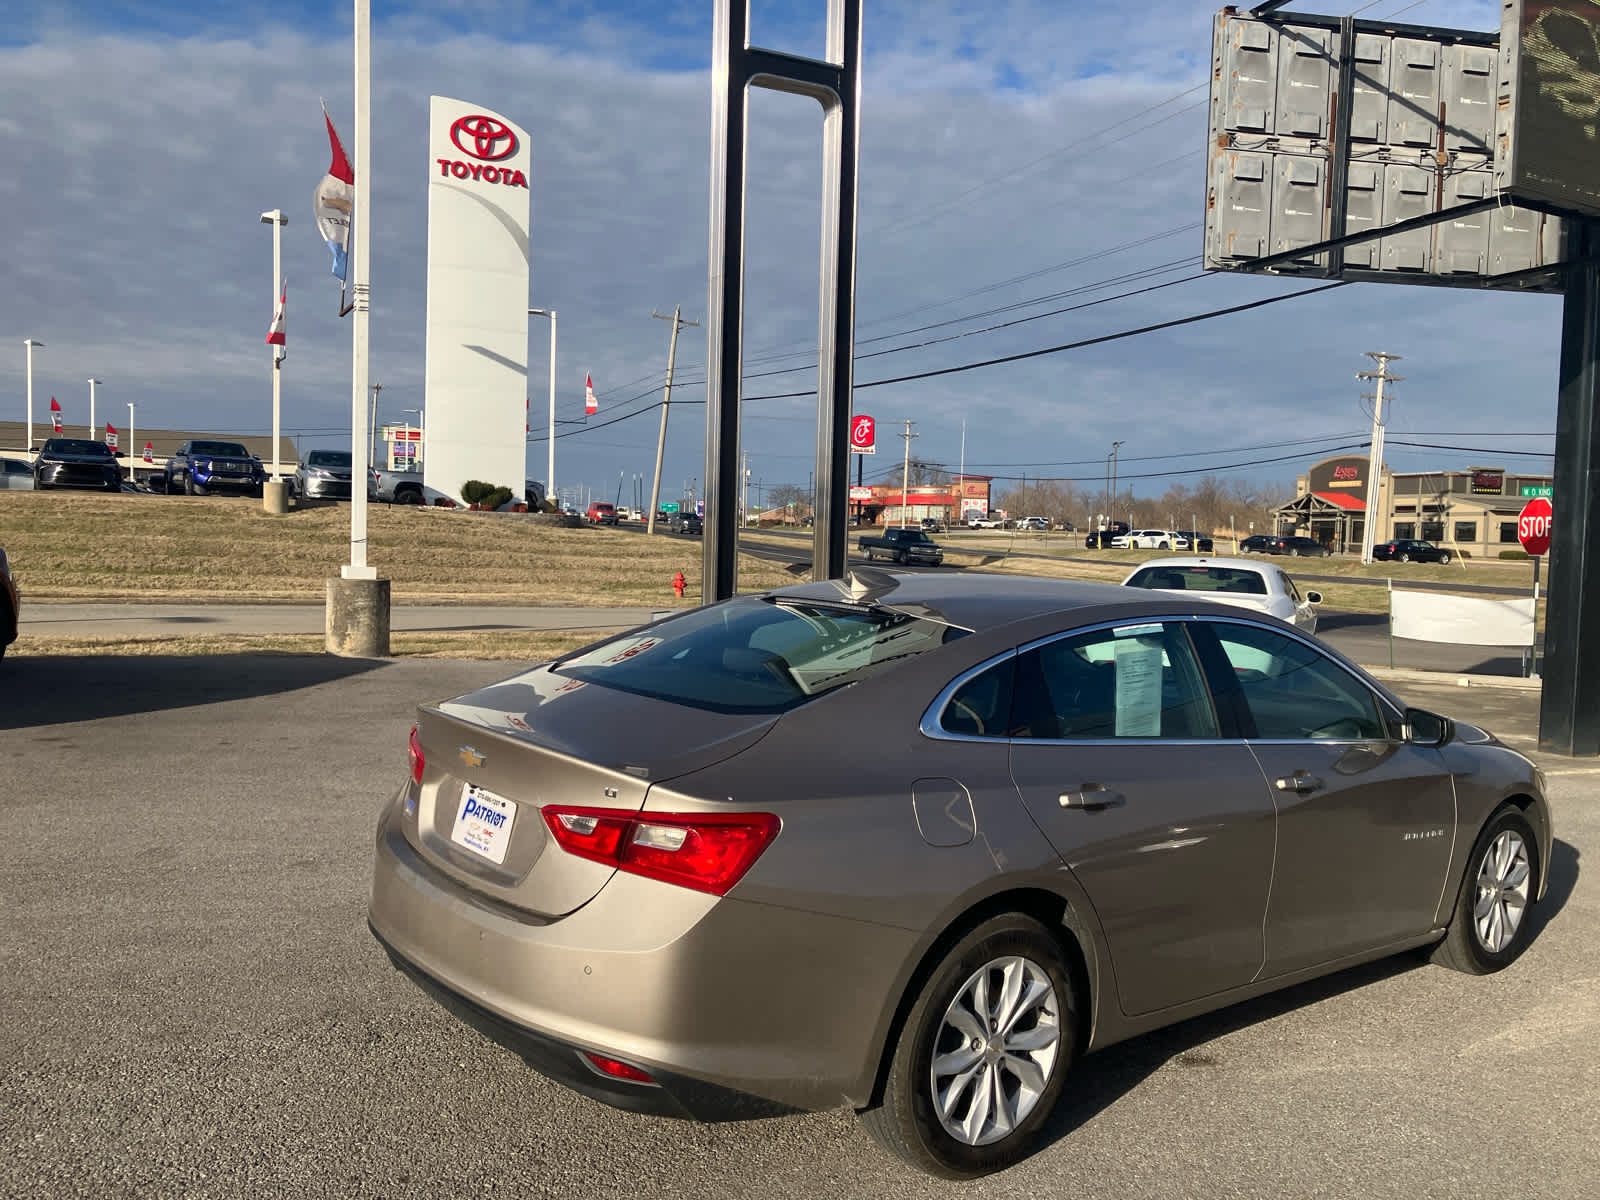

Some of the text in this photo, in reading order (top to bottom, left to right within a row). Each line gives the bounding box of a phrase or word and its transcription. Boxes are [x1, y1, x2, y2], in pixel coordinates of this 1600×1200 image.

[436, 158, 527, 188] TOYOTA
[1523, 488, 1529, 496] W
[1538, 488, 1551, 496] KING
[462, 797, 507, 829] PATRIOT
